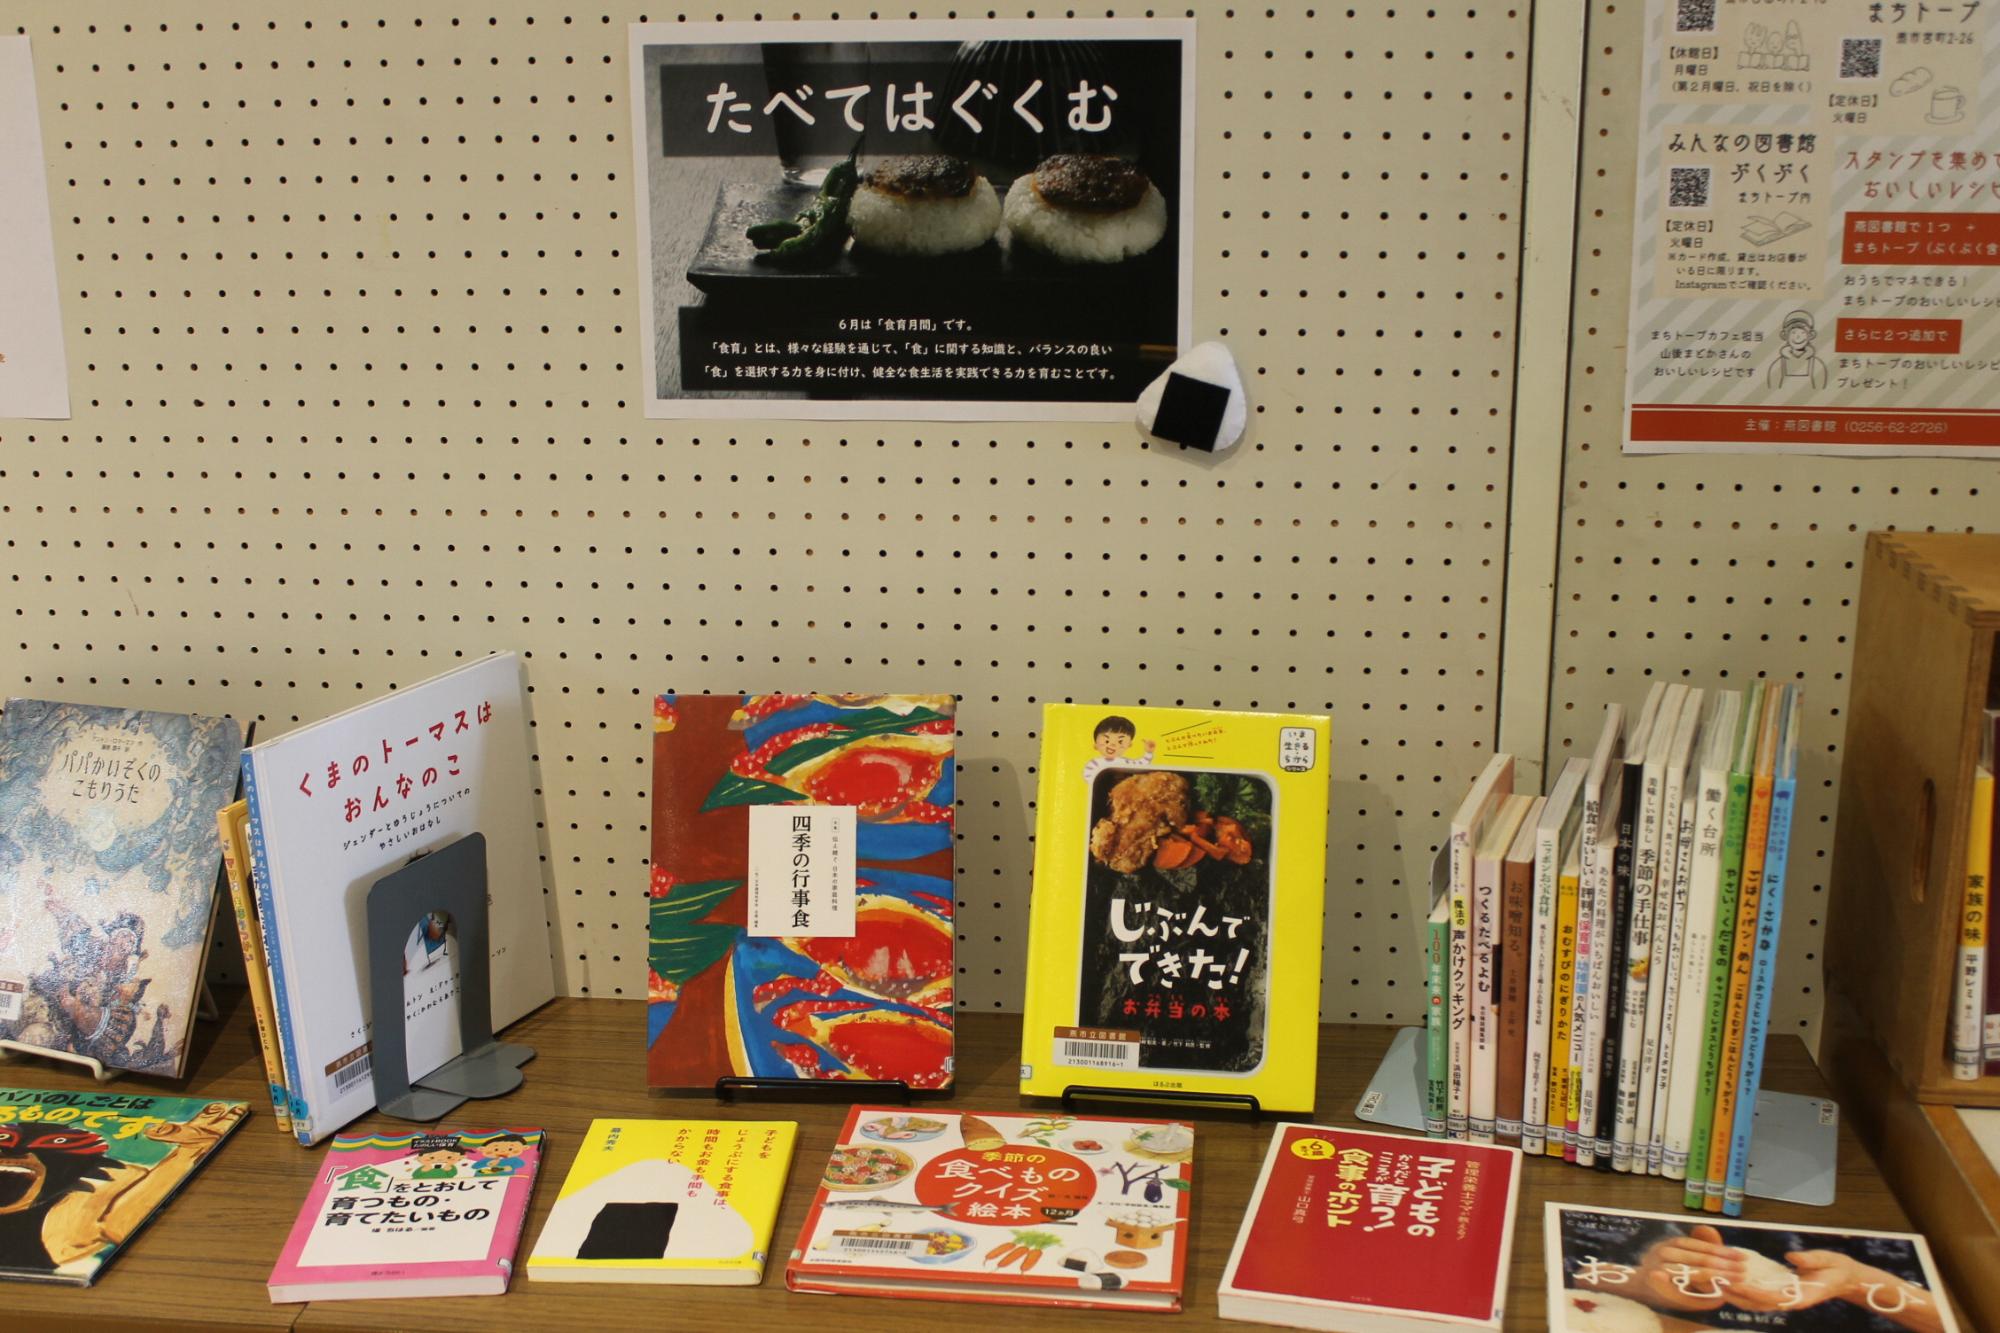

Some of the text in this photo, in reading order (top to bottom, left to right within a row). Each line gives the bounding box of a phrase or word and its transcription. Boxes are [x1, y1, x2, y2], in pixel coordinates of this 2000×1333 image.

[1868, 1, 1980, 24] まちトープ
[1674, 64, 1708, 76] 月曜日
[705, 80, 1118, 135] たべてはぐくむ
[1668, 133, 1817, 154] みんなの図書館
[1669, 237, 1704, 249] 火曜日
[838, 318, 973, 332] 6月は「食育月間」です。
[711, 341, 1113, 356] 「食育」とは、様々な経験を通じて、「食」に関する知識と、バランスの良い
[704, 365, 1116, 380] 「食」を選択する力を身に付け、健全な食生活を実践できる力を育むことです。
[60, 750, 161, 783] パパかいぞくの
[299, 700, 492, 798] くまのトーマスは
[72, 779, 140, 804] こもりうた
[343, 754, 461, 823] おんなのこ
[1700, 787, 1722, 860] 働く台所
[792, 815, 811, 928] 四季の行事食
[1110, 898, 1251, 943] じぶんで
[1508, 881, 1523, 957] お味噌知る。
[1632, 848, 1656, 947] 季節の手仕事
[1715, 868, 1738, 968] やさい・くだもの
[1759, 874, 1779, 951] にく・さかな
[1964, 874, 1984, 941] 家族の味
[1478, 886, 1492, 993] つくるたべるよむ
[1736, 870, 1761, 976] ごはん・パン・めん
[1118, 944, 1250, 990] できた！
[1451, 929, 1467, 1031] 声かけクッキング
[1556, 924, 1574, 1041] おむすびのにぎりかた
[1122, 998, 1231, 1021] お弁当の本
[667, 1128, 692, 1165] かからない
[687, 1128, 721, 1198] 時間もお金も手間も
[759, 1129, 778, 1159] 子どもを
[981, 1151, 1046, 1163] 季節の
[324, 1164, 499, 1194] 「食」をとおして
[713, 1128, 749, 1210] じょうぶにする食事は、
[934, 1158, 1080, 1185] 食べもの
[1326, 1148, 1374, 1228] 食事のホント
[1396, 1153, 1414, 1185] からだと
[952, 1182, 1050, 1204] クイズ
[966, 1202, 1032, 1219] 絵本
[1362, 1182, 1411, 1233] 育つ！
[1407, 1155, 1455, 1237] 子どもの
[324, 1208, 490, 1227] 育てたいもの
[1571, 1254, 1928, 1314] おむすび
